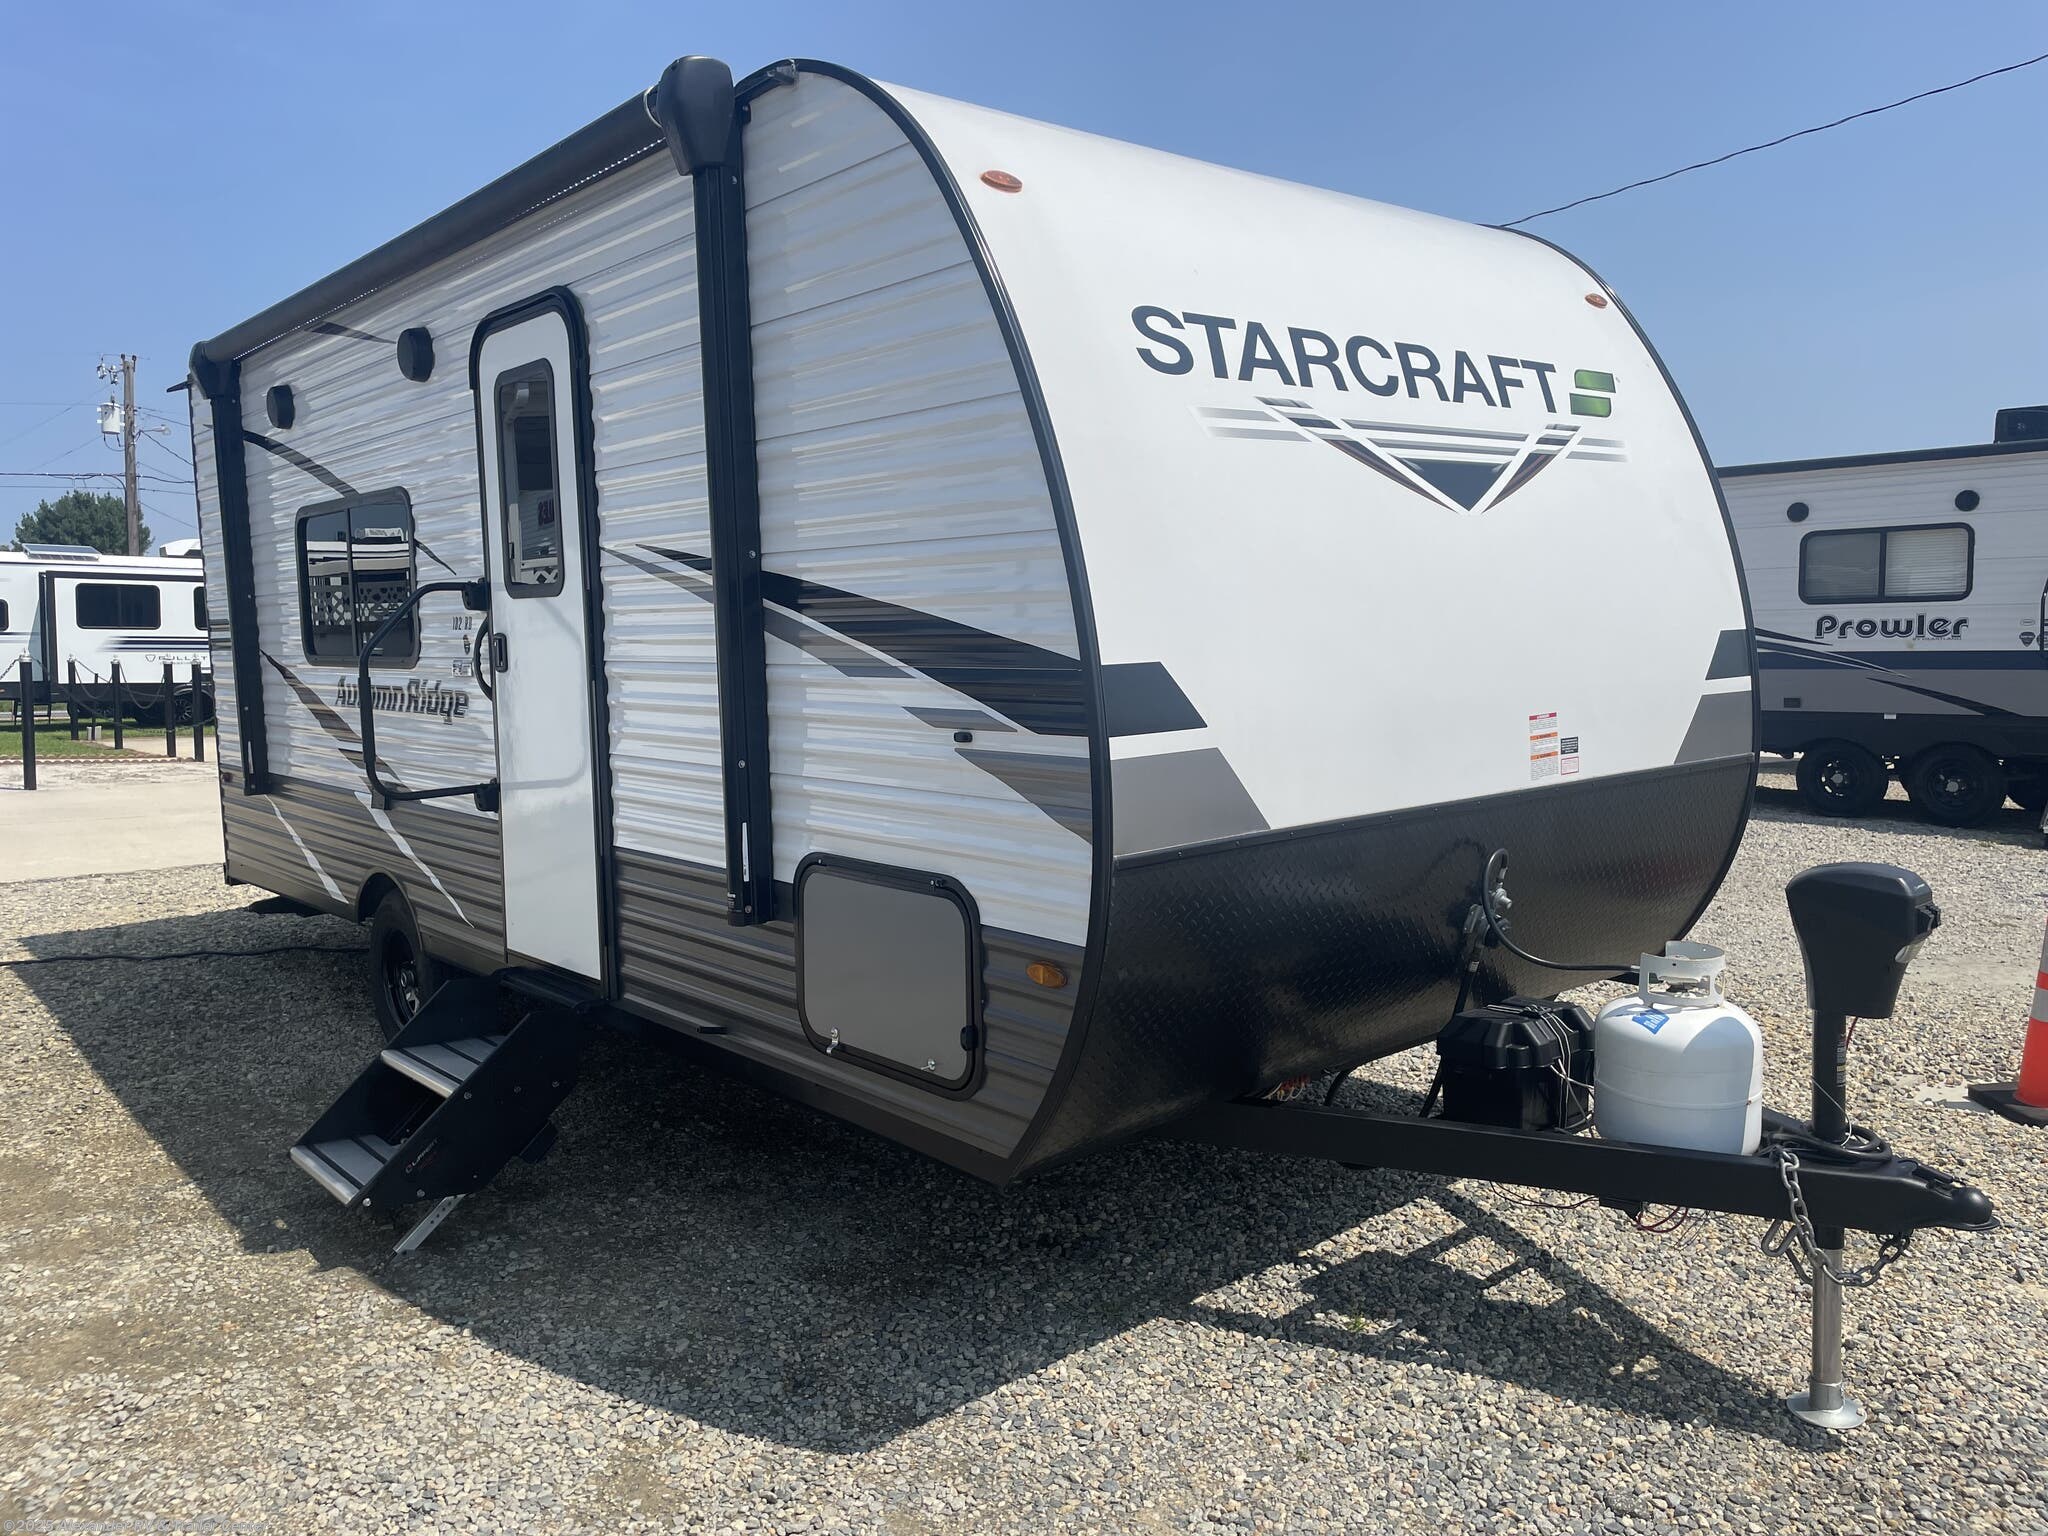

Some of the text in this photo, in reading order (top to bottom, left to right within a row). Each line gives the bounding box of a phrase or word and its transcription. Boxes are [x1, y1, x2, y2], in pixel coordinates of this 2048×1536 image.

[1131, 305, 1557, 413] STARCRAFT
[1815, 612, 1969, 640] Prowler
[335, 676, 469, 725] AumnRidge
